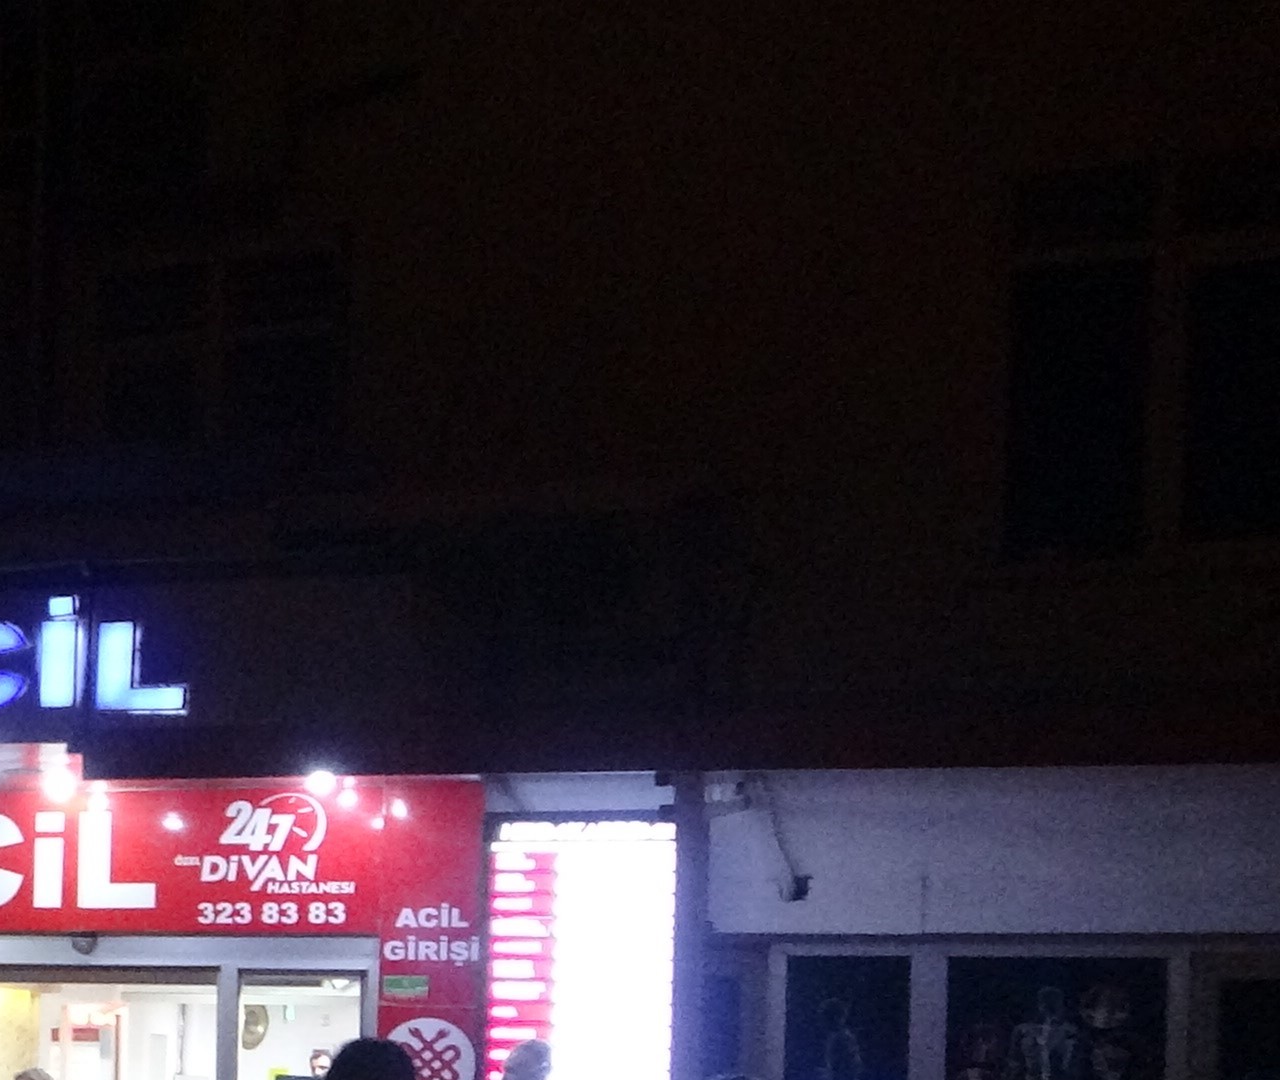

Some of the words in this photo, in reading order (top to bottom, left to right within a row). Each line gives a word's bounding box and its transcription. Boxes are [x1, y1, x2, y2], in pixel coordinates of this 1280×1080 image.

[197, 902, 252, 924] 323
[261, 902, 299, 924] 83
[308, 902, 346, 924] 83
[395, 903, 469, 928] ACİL
[383, 935, 480, 966] GİRİŞİ
